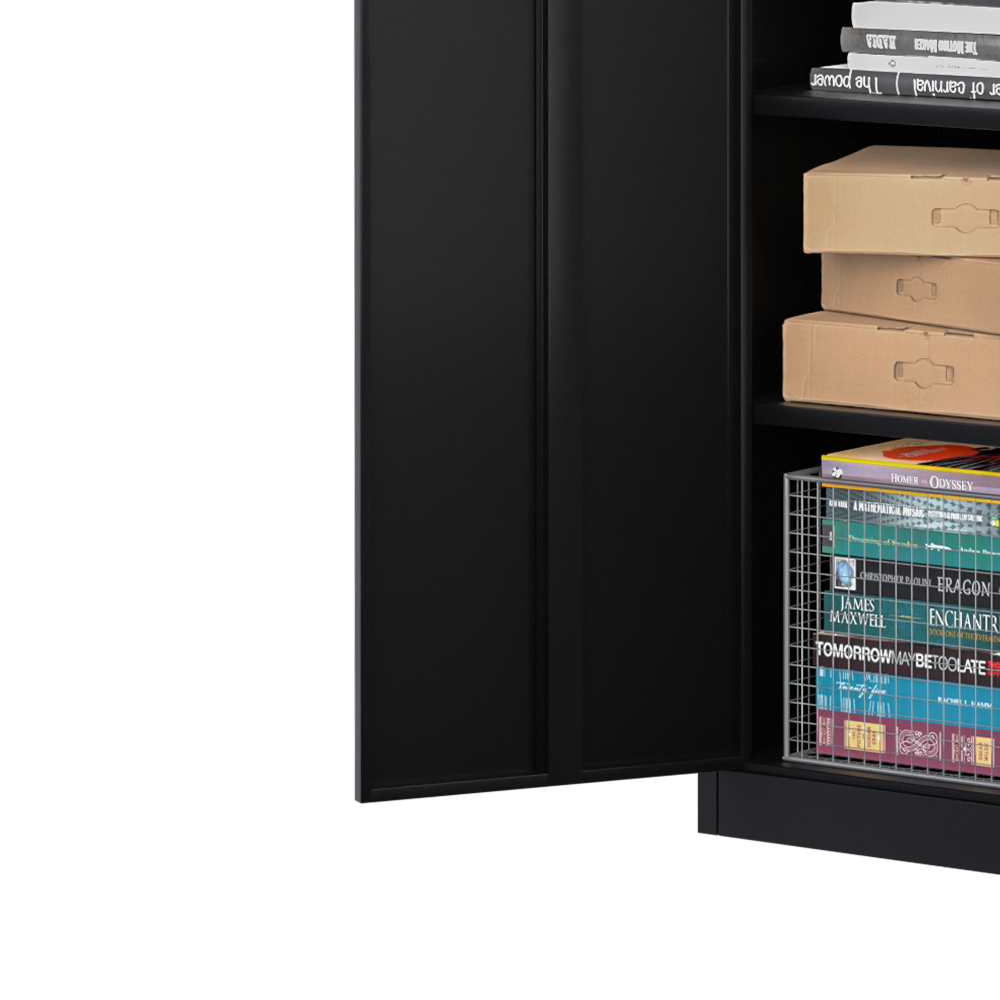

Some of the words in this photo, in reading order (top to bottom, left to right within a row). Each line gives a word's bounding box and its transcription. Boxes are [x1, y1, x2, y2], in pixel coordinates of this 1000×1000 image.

[913, 38, 938, 53] MAKER
[937, 39, 964, 55] MOTION
[810, 69, 853, 89] power
[855, 76, 883, 94] The
[913, 77, 966, 98] carnival
[971, 81, 985, 100] of
[891, 473, 919, 485] HOMER
[929, 475, 974, 491] ODYSSEY
[858, 501, 902, 516] MATHEMATICAL
[859, 571, 904, 584] CHRISTOPHER
[936, 576, 992, 598] ERAGON
[840, 595, 875, 612] JAMES
[829, 609, 886, 629] MAXWELL
